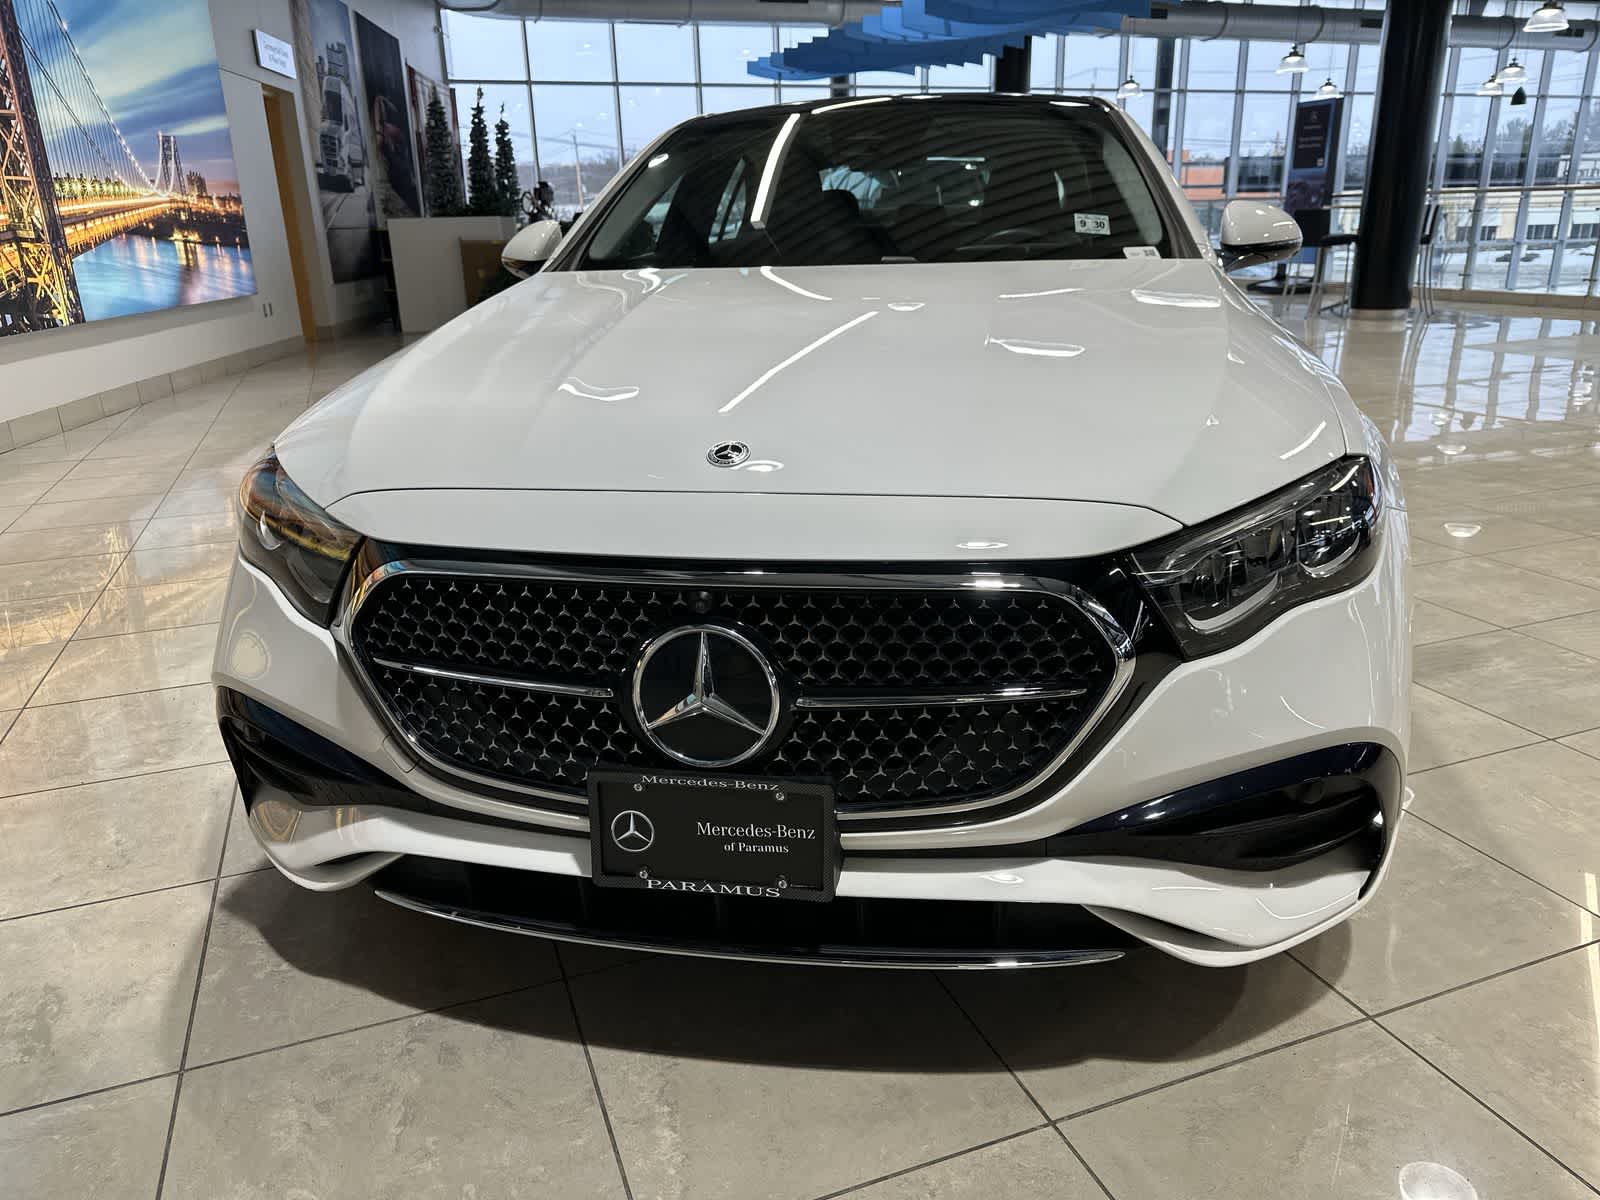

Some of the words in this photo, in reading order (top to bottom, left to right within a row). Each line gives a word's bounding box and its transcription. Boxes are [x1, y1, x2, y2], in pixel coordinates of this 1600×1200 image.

[641, 775, 779, 791] Mercedes-Benz
[696, 822, 816, 840] Mercedes-Benz
[723, 842, 736, 852] of
[738, 842, 789, 853] Paramus
[647, 879, 780, 897] PARAMUS
